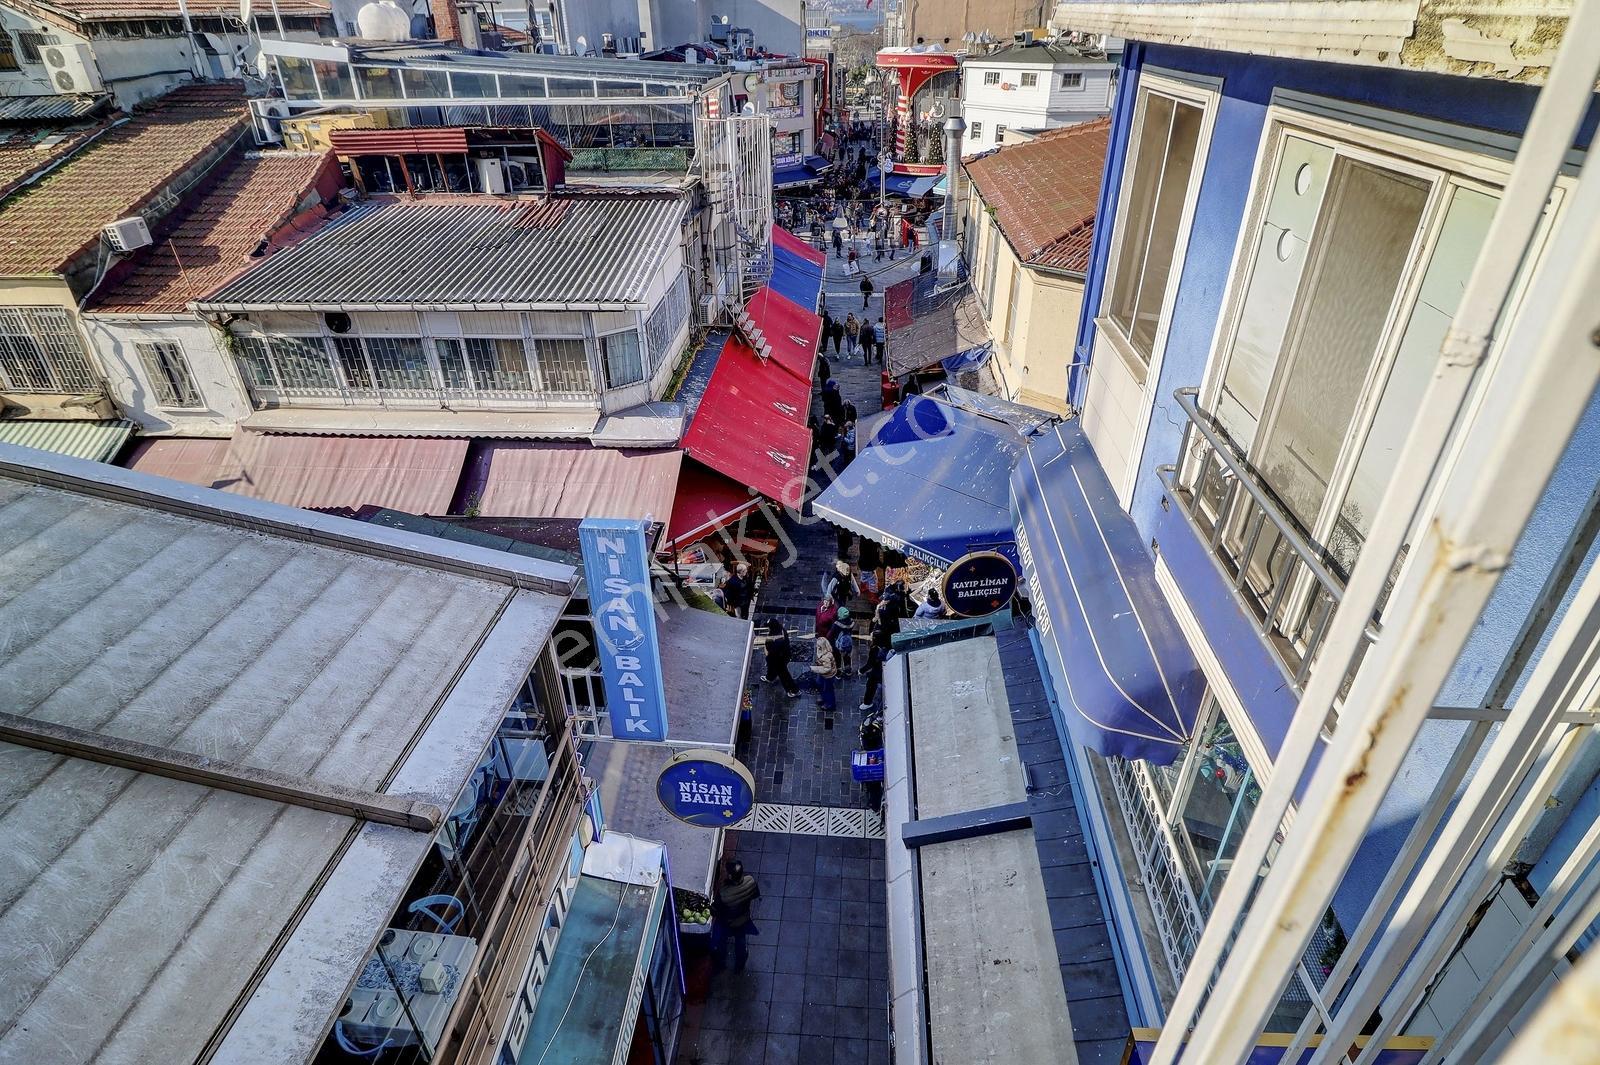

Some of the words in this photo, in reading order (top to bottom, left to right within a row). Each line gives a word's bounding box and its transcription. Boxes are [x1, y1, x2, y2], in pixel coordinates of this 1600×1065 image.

[881, 535, 905, 553] DENİZ
[597, 536, 637, 632] NİSAN
[952, 580, 979, 590] KAYIP
[979, 577, 1009, 588] LİMAN
[957, 587, 1002, 600] BALIKÇISI
[614, 655, 651, 733] BALIK
[678, 780, 733, 796] NİSAN
[680, 792, 733, 806] BALIK
[509, 858, 577, 1050] BALIK
